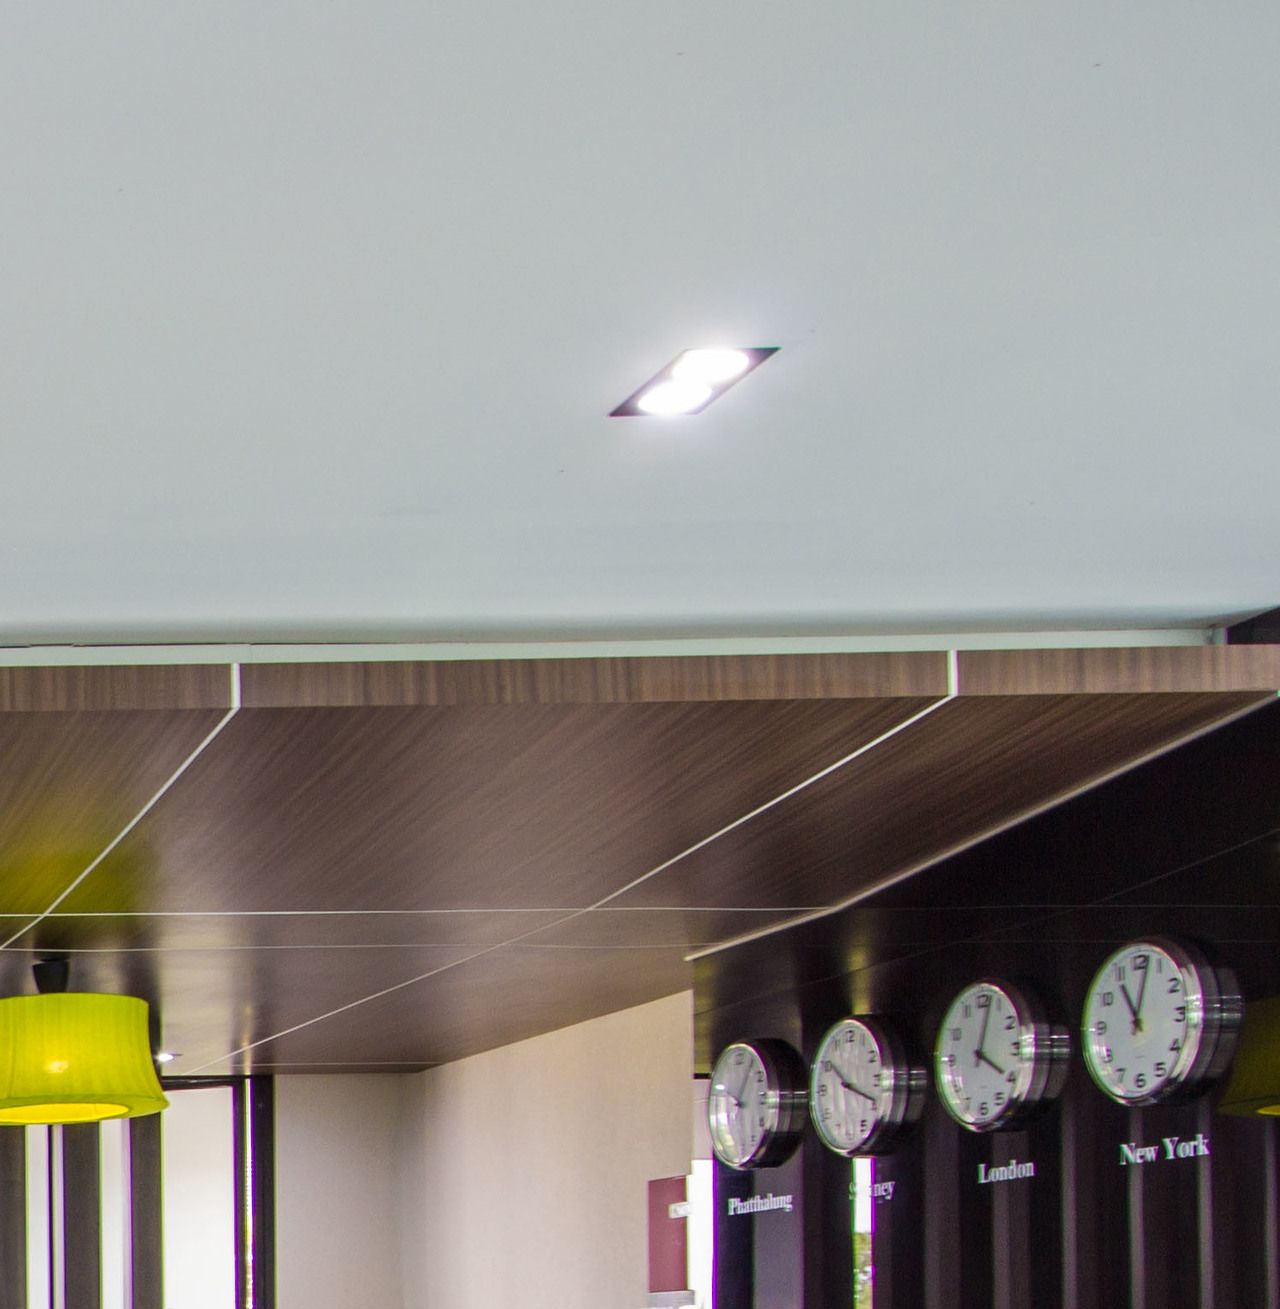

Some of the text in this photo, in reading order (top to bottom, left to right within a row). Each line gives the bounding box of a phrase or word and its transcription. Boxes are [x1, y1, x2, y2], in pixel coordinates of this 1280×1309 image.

[1131, 954, 1149, 970] 12
[1167, 978, 1181, 993] 2
[976, 993, 990, 1009] 12
[1173, 1006, 1186, 1022] 3
[1005, 1015, 1016, 1030] 2
[1095, 1021, 1108, 1035] 9
[1011, 1041, 1020, 1056] 3
[1169, 1038, 1182, 1053] 4
[868, 1049, 878, 1063] 2
[1006, 1071, 1017, 1083] 4
[1115, 1067, 1127, 1083] 7
[1154, 1062, 1167, 1077] 5
[1134, 1073, 1147, 1088] 6
[994, 1091, 1005, 1107] 5
[979, 1102, 989, 1116] 6
[1119, 1133, 1210, 1165] New York
[977, 1158, 1035, 1184] London
